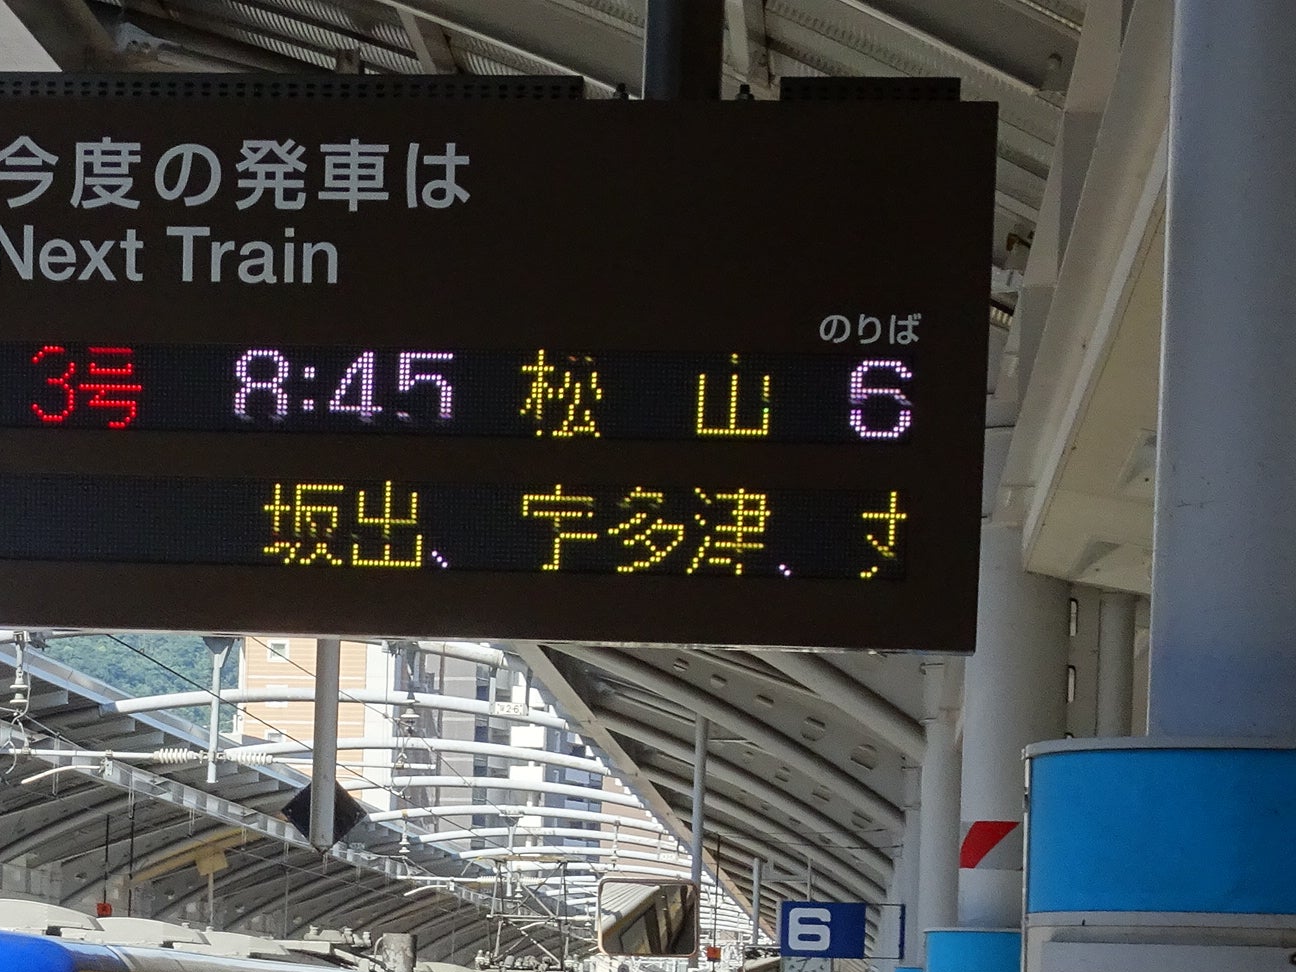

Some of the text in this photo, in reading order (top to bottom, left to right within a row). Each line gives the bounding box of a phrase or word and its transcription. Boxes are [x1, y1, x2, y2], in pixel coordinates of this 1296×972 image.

[165, 224, 340, 285] Train
[818, 312, 922, 345] のりば
[31, 345, 143, 429] 3号
[233, 348, 454, 424] 8:45
[848, 358, 914, 440] 6
[788, 907, 832, 952] 6
